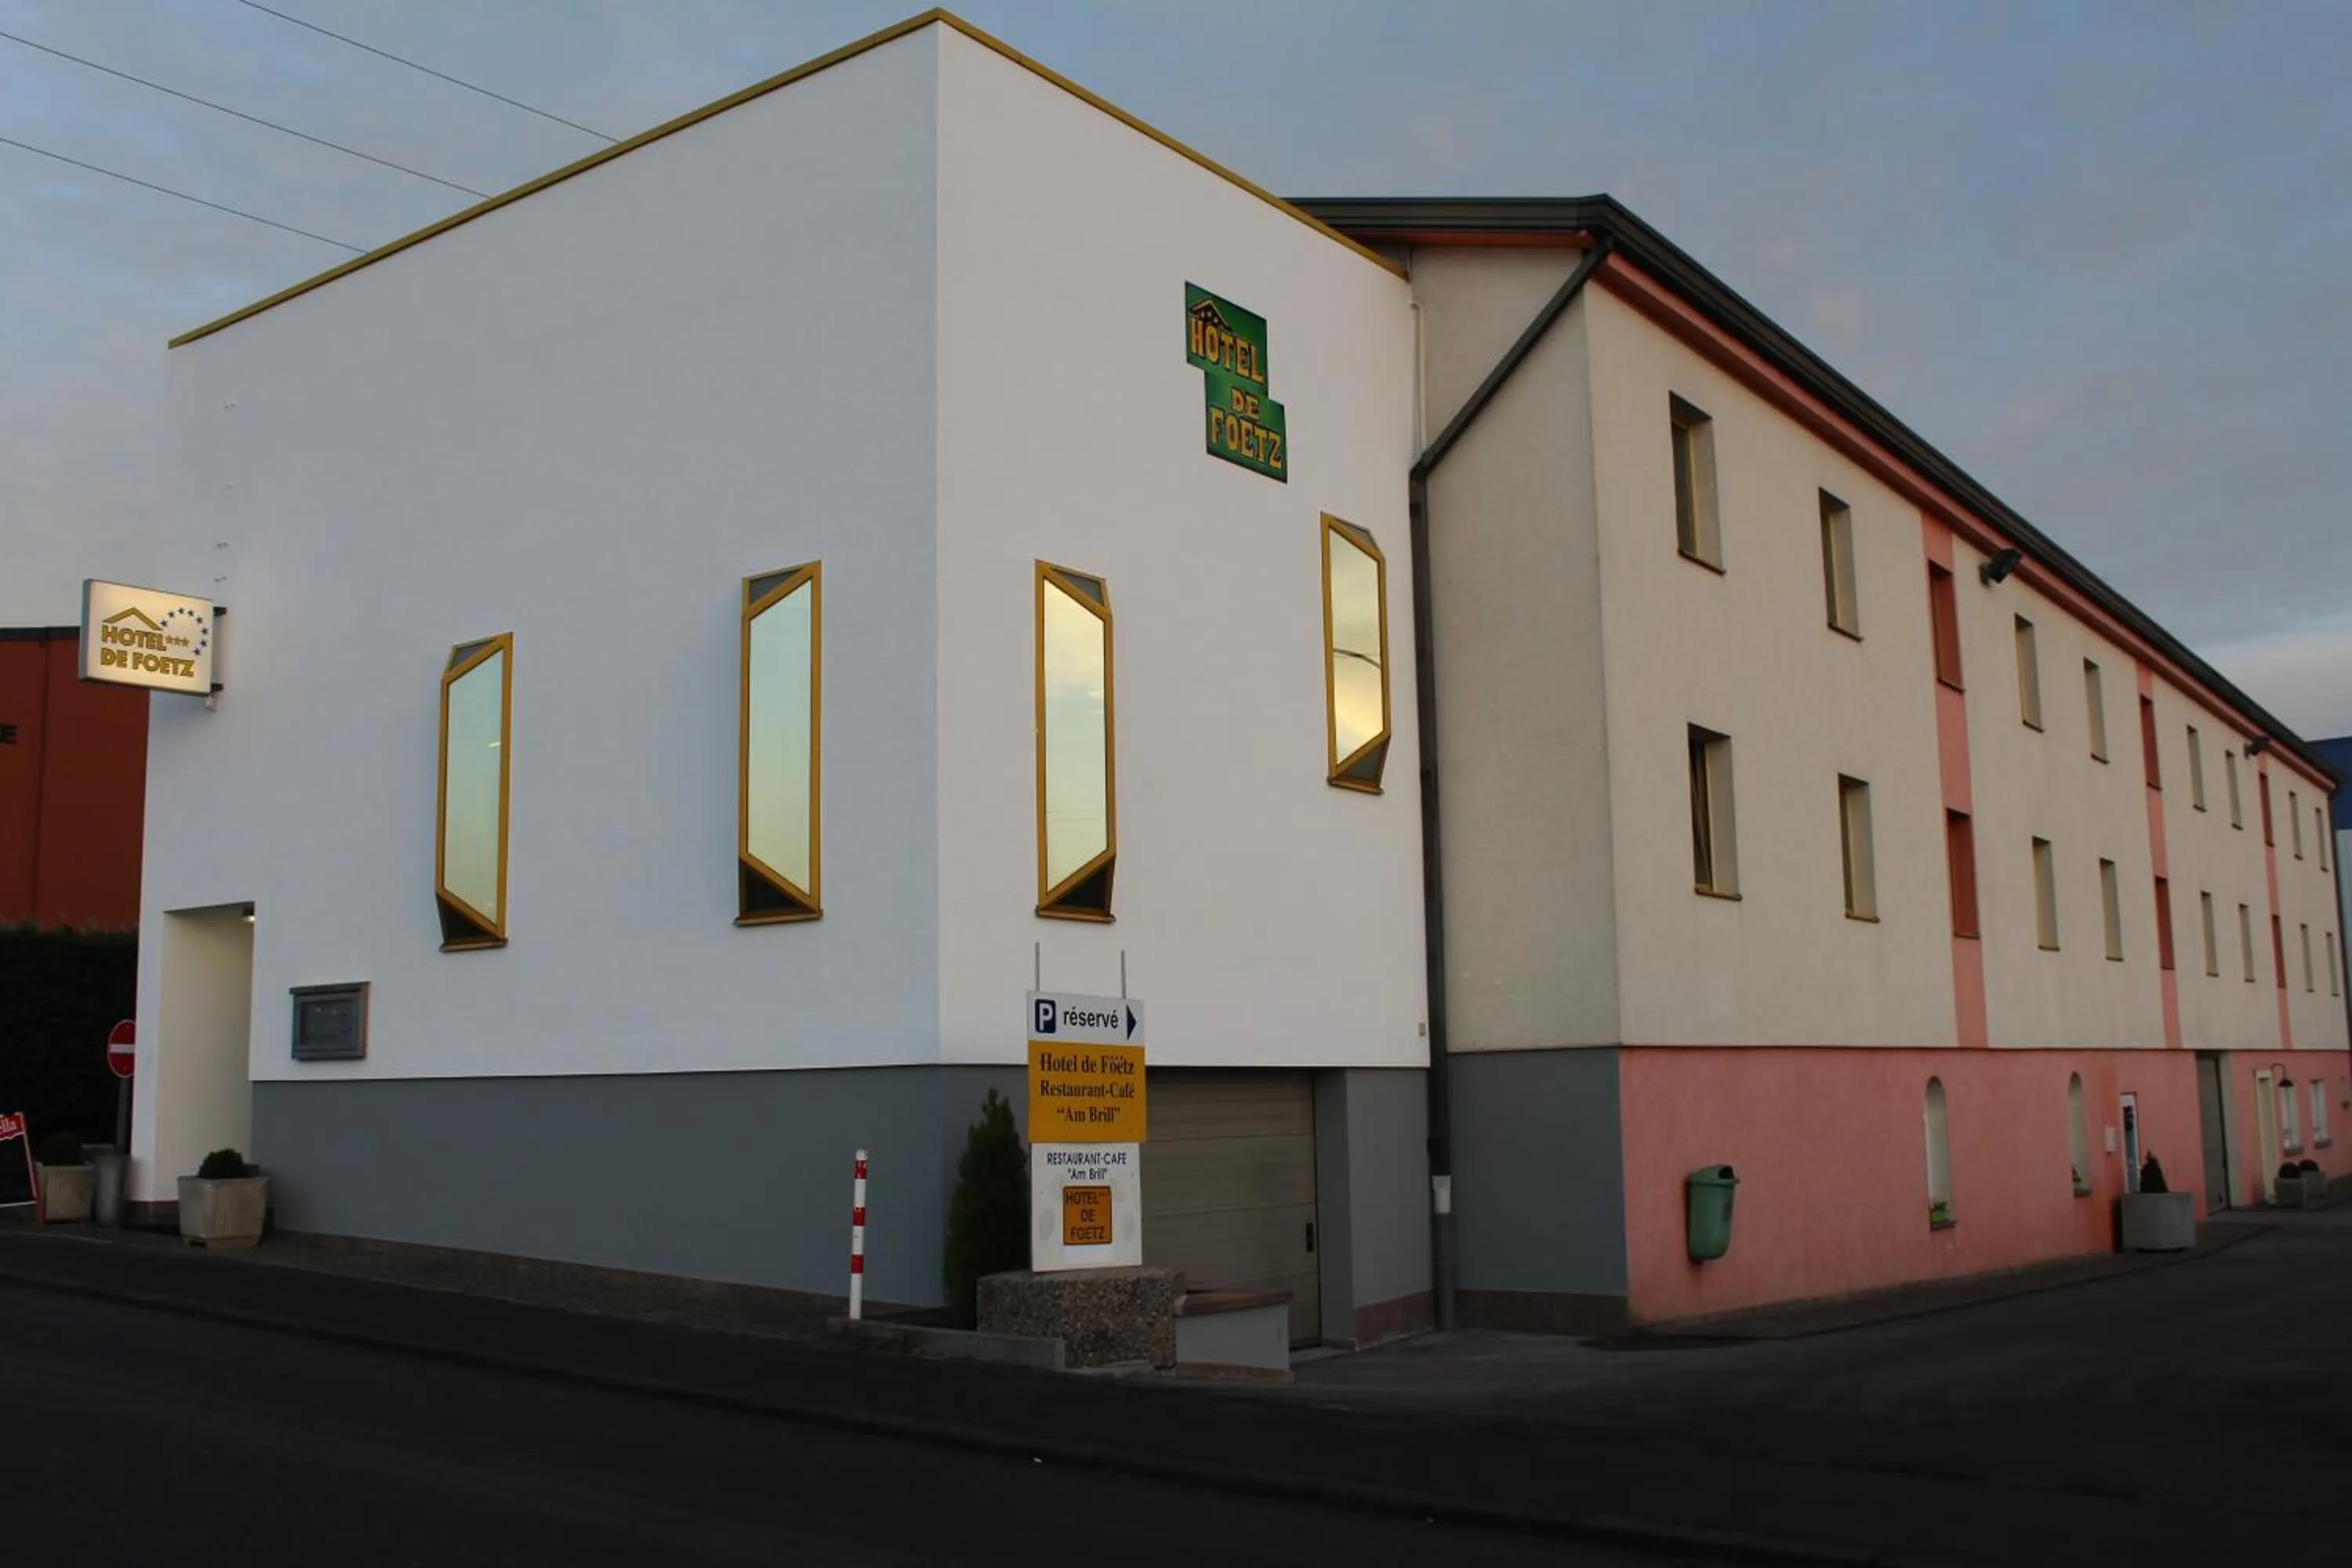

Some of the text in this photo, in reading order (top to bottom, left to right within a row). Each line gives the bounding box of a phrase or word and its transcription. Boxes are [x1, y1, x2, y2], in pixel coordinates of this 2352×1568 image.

[1192, 318, 1264, 383] HOTEL
[1232, 387, 1259, 419] DE
[1210, 406, 1281, 469] FOETZ
[101, 625, 166, 651] HOTEL
[100, 648, 194, 677] DE FOETZ
[1039, 1003, 1119, 1031] P réservé
[1040, 1053, 1077, 1073] Hotel
[1082, 1055, 1097, 1073] de
[1040, 1080, 1135, 1098] Restaurant-Café
[1047, 1152, 1127, 1166] RESTAURANT-CAFE
[1066, 1192, 1099, 1205] HOTEL
[1081, 1209, 1096, 1222] DE
[1071, 1226, 1105, 1240] FOETZ
